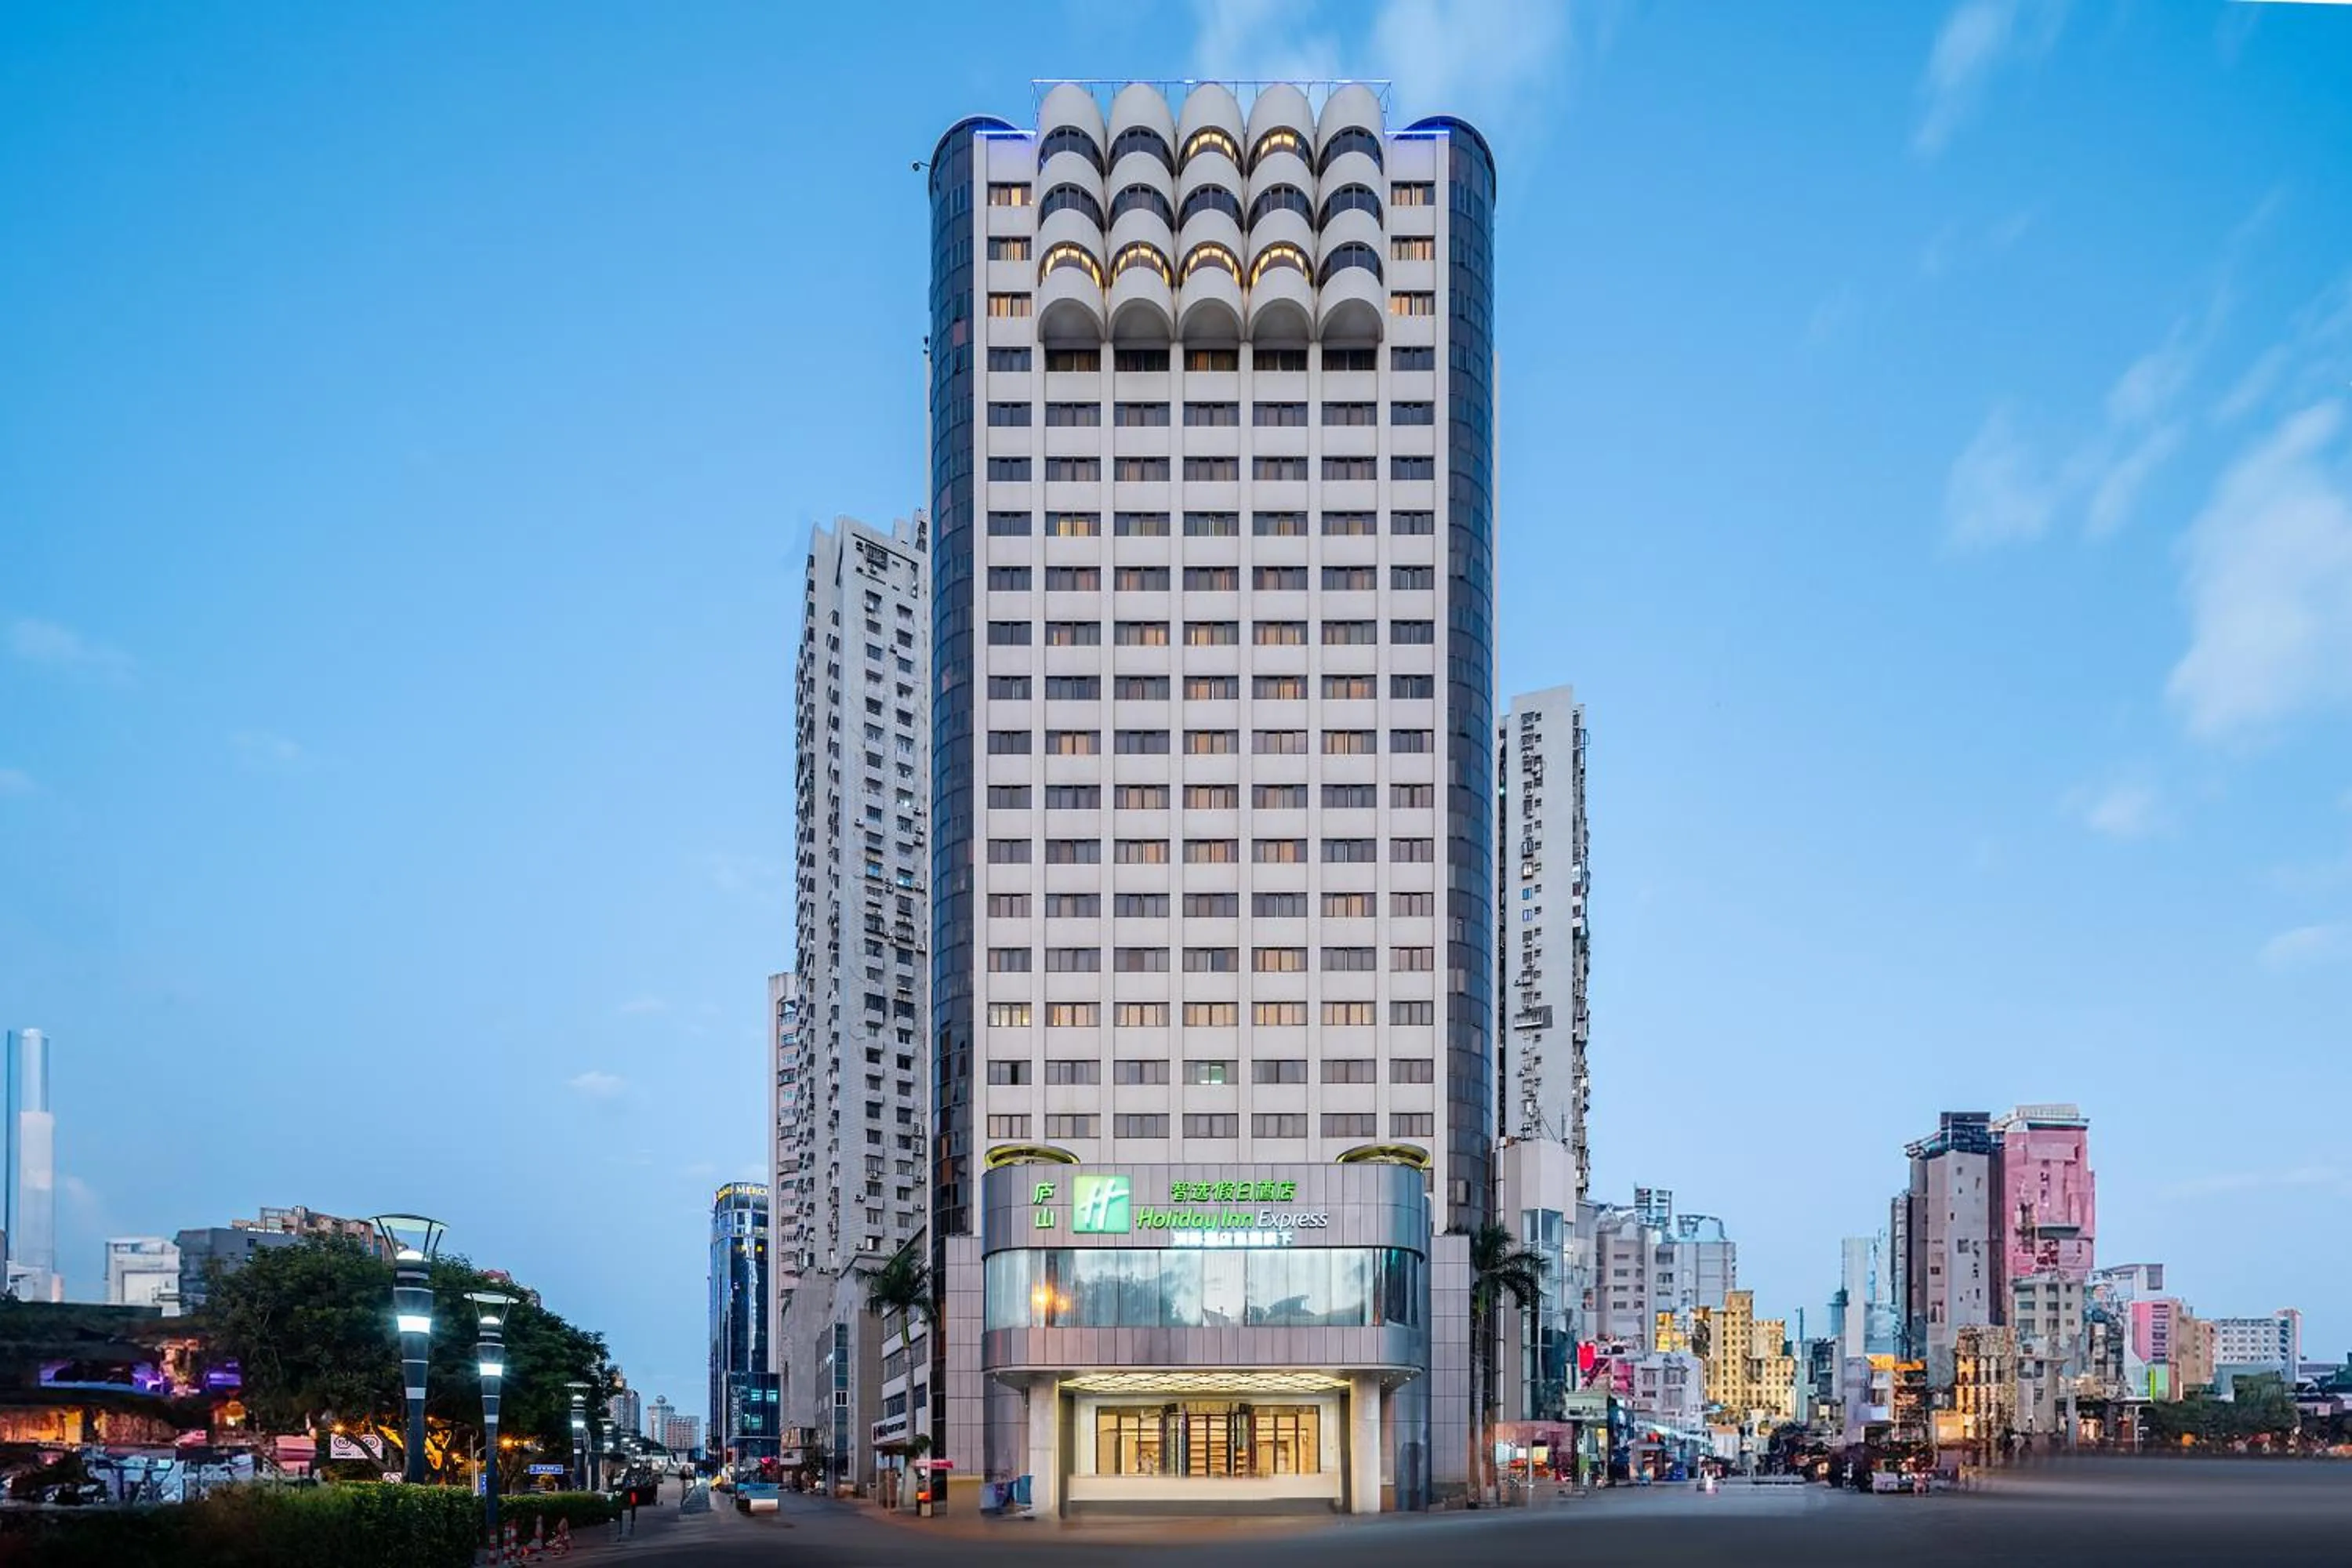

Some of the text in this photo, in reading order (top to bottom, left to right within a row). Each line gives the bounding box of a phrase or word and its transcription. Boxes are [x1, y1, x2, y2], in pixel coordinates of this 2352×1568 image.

[1171, 1179, 1296, 1202] 智选假日酒店
[1033, 1181, 1055, 1229] 庐山
[1137, 1205, 1328, 1232] Holiday Inn Express
